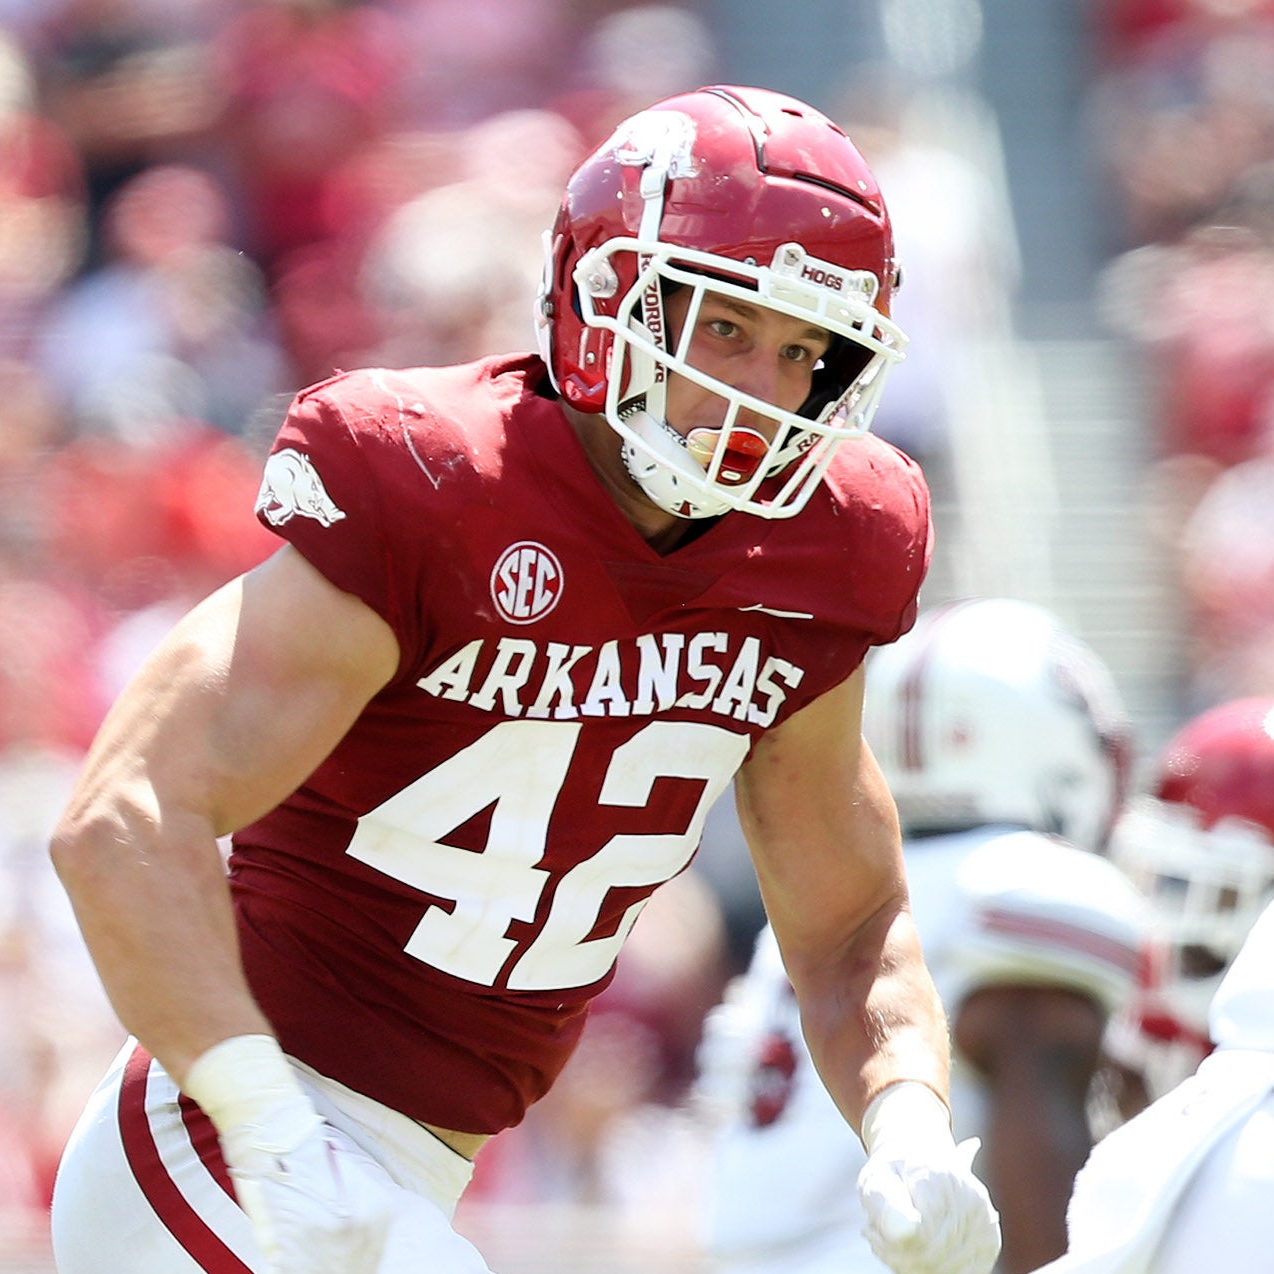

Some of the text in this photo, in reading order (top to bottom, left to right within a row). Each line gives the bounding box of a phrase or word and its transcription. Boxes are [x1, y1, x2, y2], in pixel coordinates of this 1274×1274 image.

[800, 264, 844, 291] HOGS
[497, 548, 557, 618] SEC
[417, 632, 804, 728] ARKANSAS
[346, 720, 751, 990] 42
